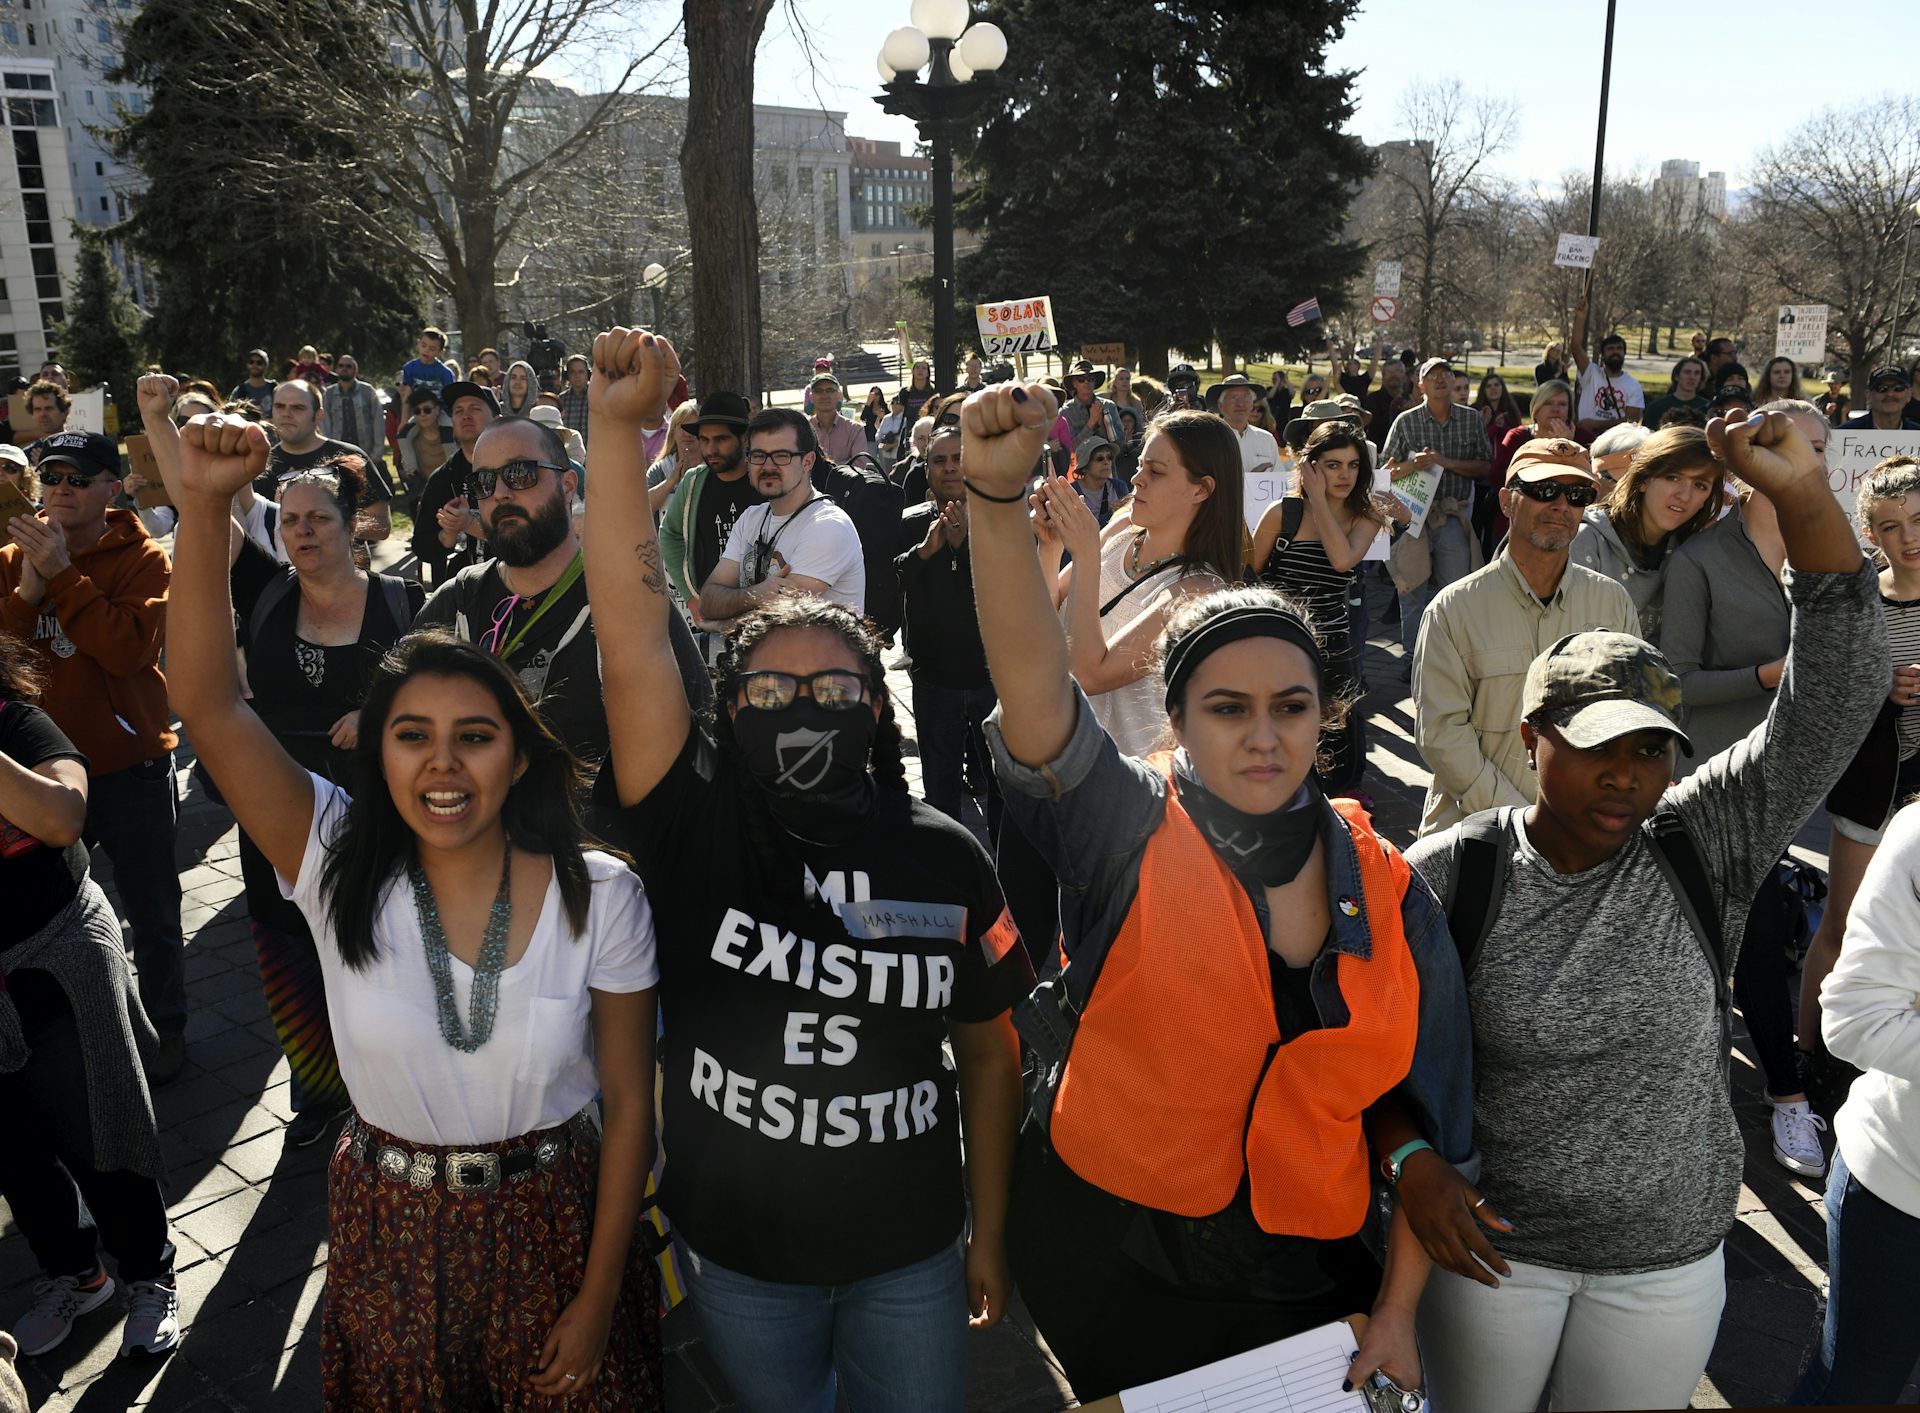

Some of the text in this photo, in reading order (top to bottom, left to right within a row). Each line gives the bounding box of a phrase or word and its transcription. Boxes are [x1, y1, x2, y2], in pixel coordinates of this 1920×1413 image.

[1558, 253, 1590, 262] FRACKING
[988, 301, 1046, 322] SOLAR
[1798, 306, 1827, 314] INJUSTICE
[1794, 331, 1821, 339] JUSTICE
[1797, 323, 1825, 331] THREAT
[990, 331, 1050, 353] SPILL
[1777, 339, 1815, 347] EVERYWHERE
[65, 434, 88, 443] SIERRA
[1842, 436, 1920, 458] FRACKI
[1405, 483, 1430, 505] CHANGE
[1410, 502, 1425, 517] NOW
[862, 911, 955, 929] MARSHALL
[710, 906, 955, 1010] EXISTIR
[783, 1011, 862, 1067] ES
[690, 1047, 938, 1148] RESISTIR
